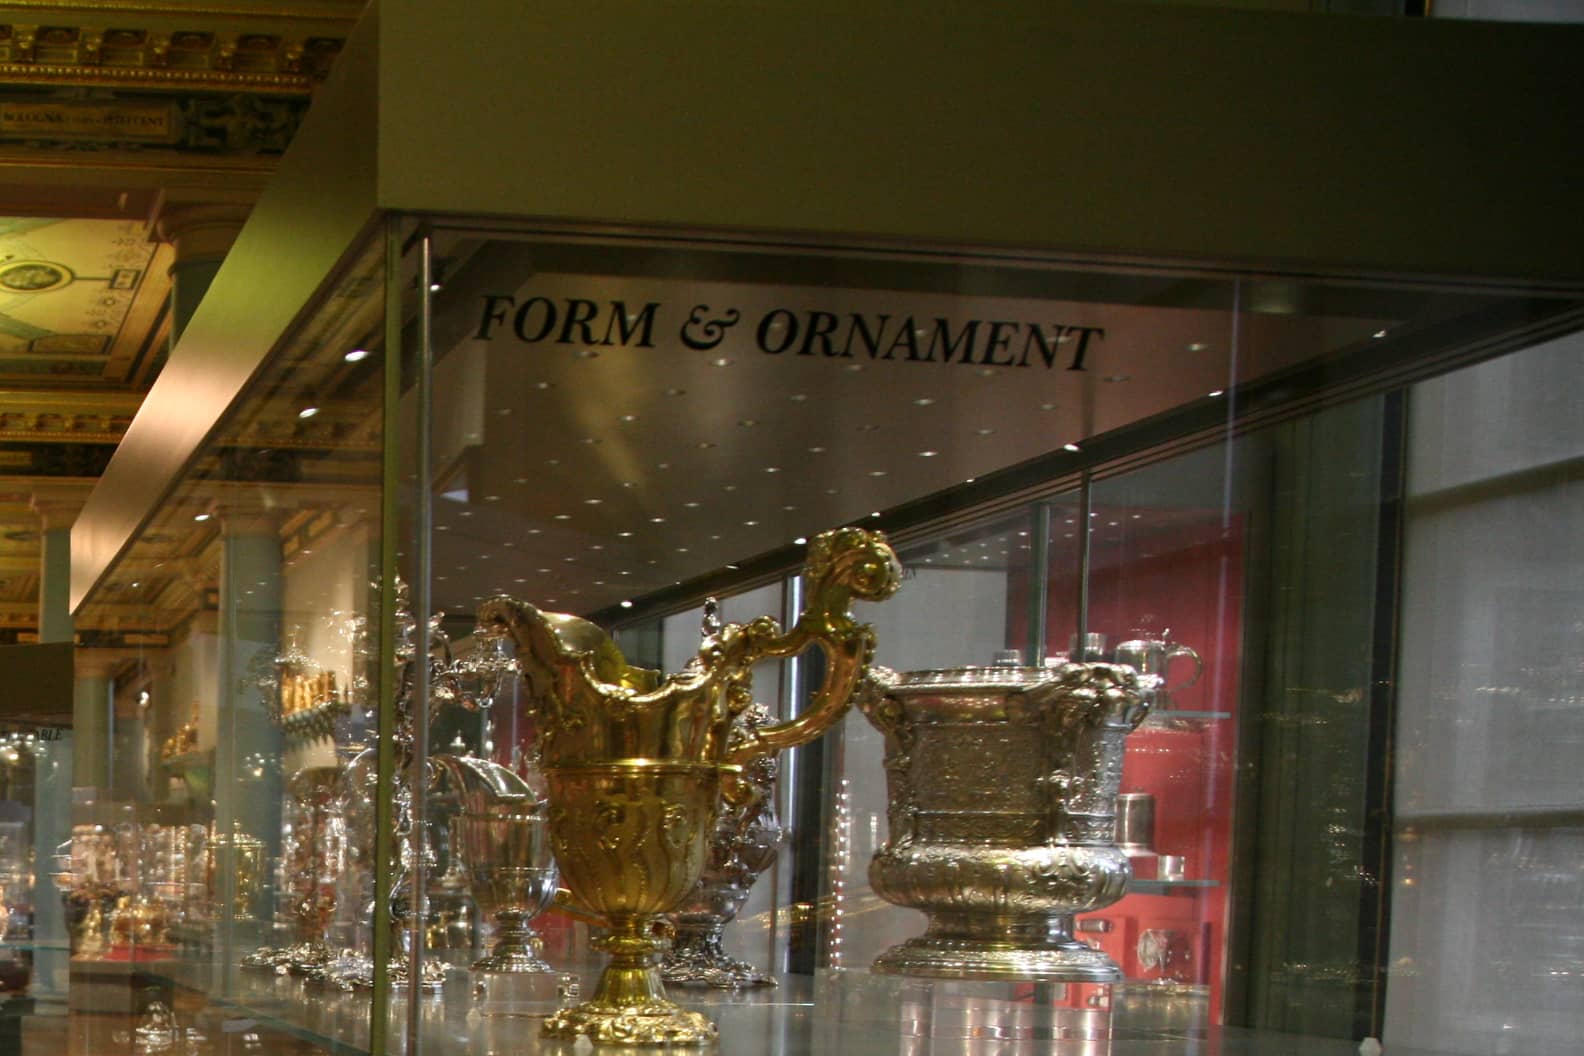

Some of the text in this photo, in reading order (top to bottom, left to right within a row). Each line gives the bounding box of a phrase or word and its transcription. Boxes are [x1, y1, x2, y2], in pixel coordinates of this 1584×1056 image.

[472, 295, 1104, 371] FORM & ORNAMENT
[25, 727, 64, 742] ABLE
